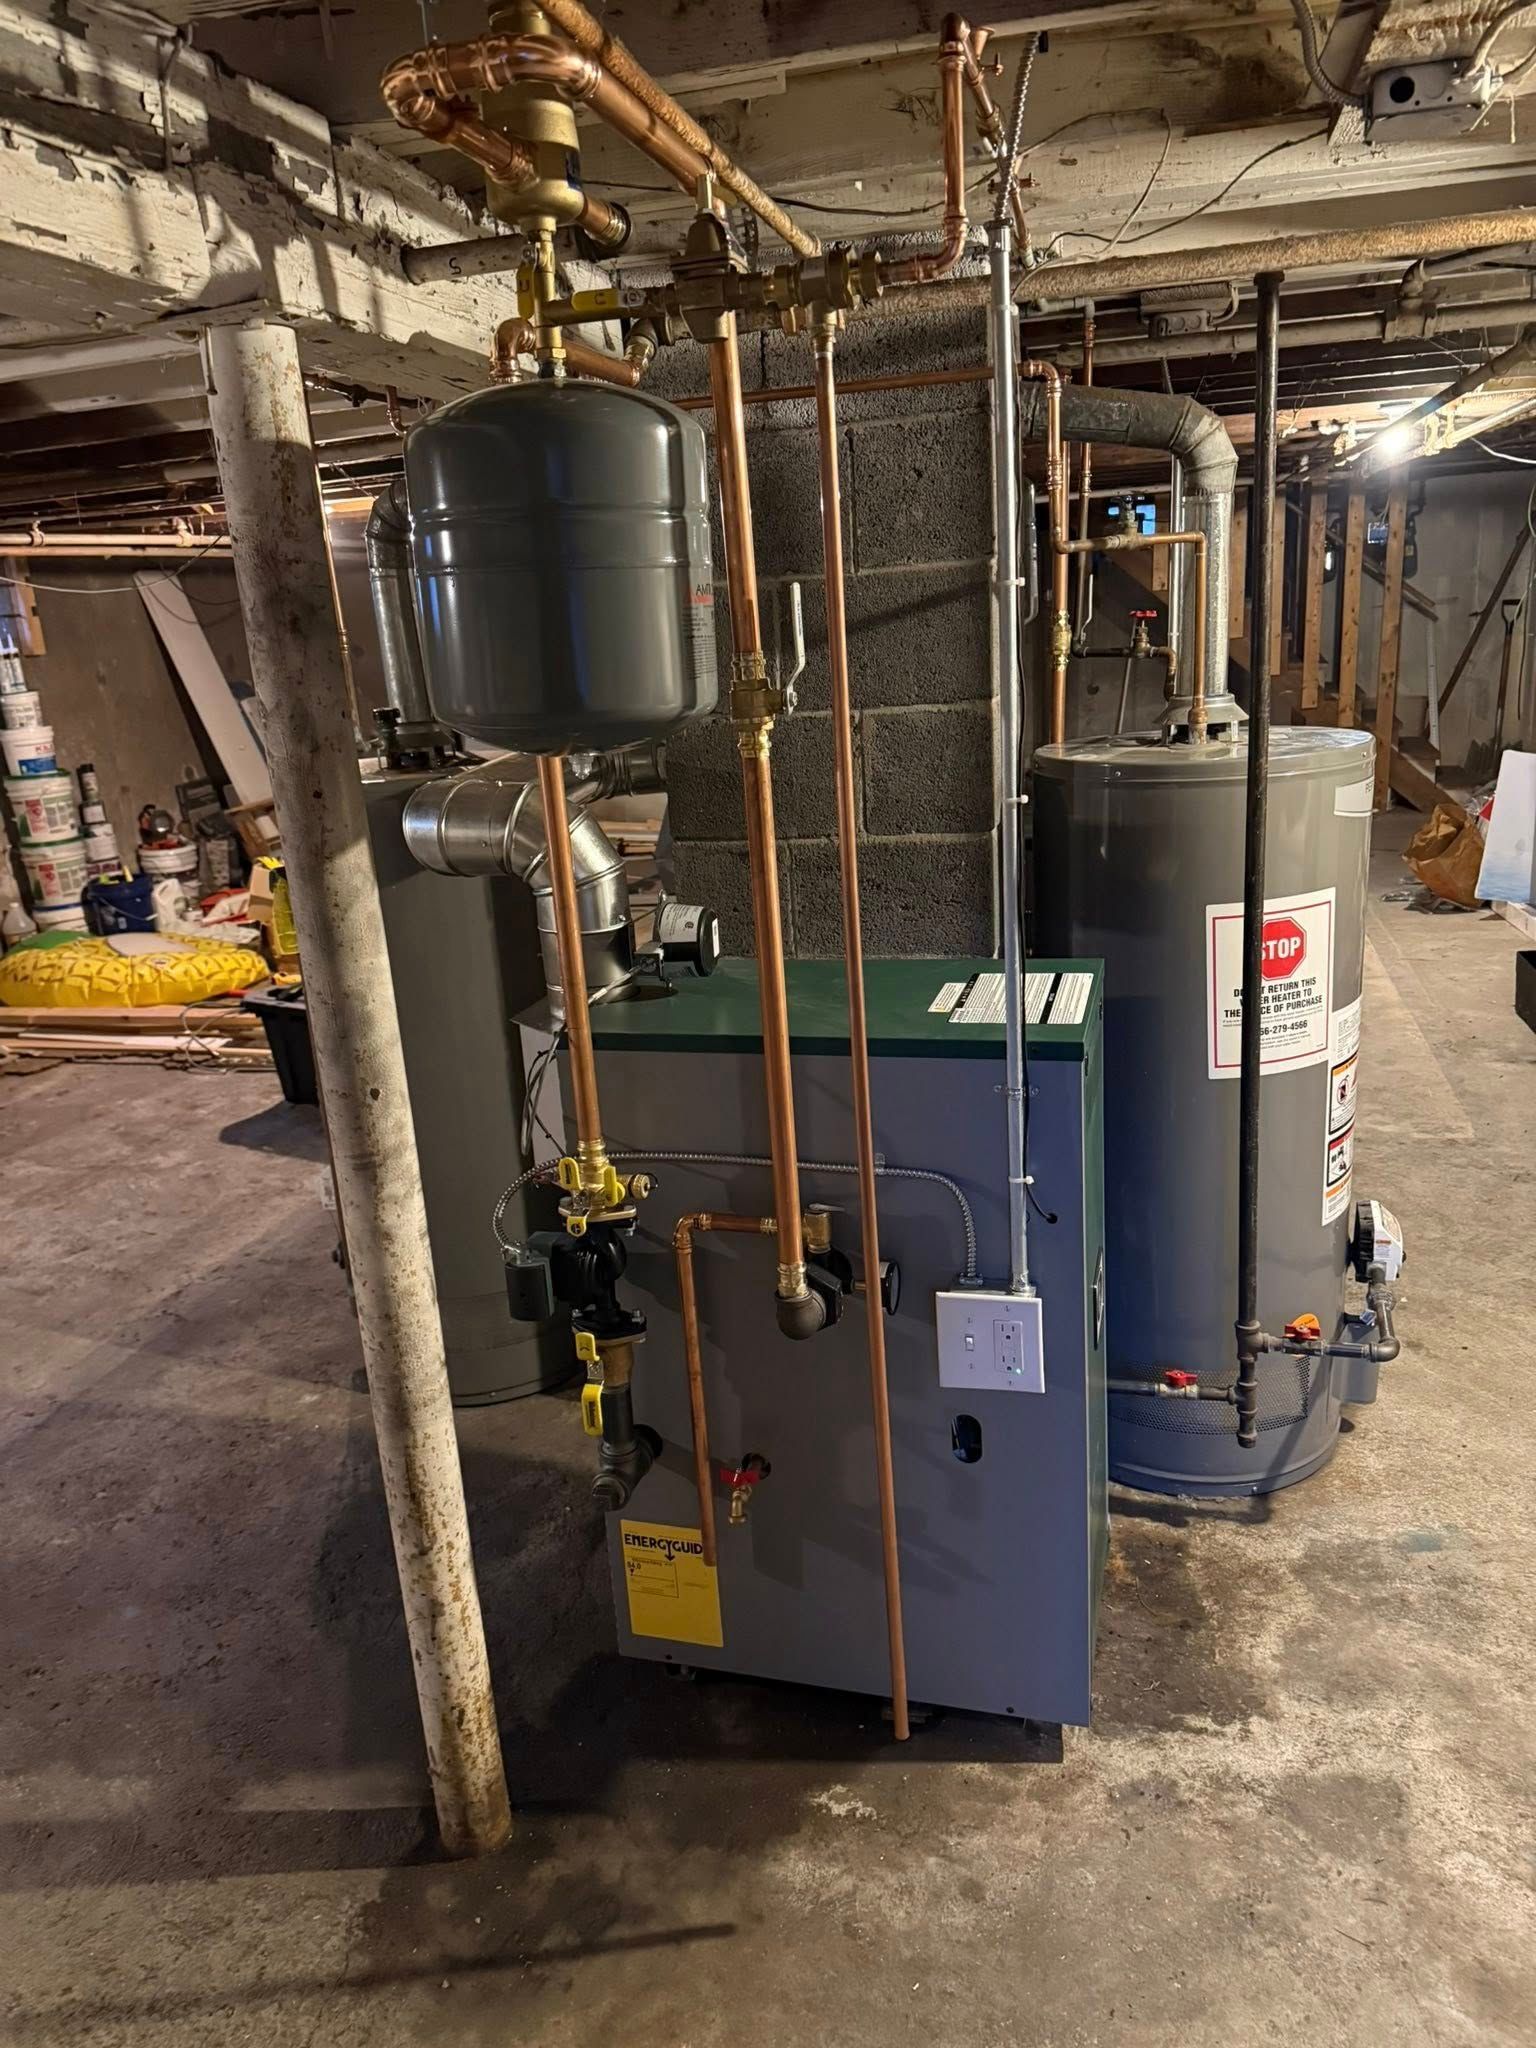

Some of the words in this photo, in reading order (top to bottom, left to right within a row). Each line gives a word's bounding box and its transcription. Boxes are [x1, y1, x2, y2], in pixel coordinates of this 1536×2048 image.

[1268, 981, 1299, 994] RETURN
[1301, 977, 1317, 988] THIS
[1271, 991, 1301, 1004] HEATER
[1303, 988, 1312, 998] TO
[1224, 1009, 1241, 1018] THE
[1273, 1004, 1284, 1013] OF
[1286, 995, 1323, 1011] PURCHASE
[624, 1534, 703, 1557] ENERGYGUID
